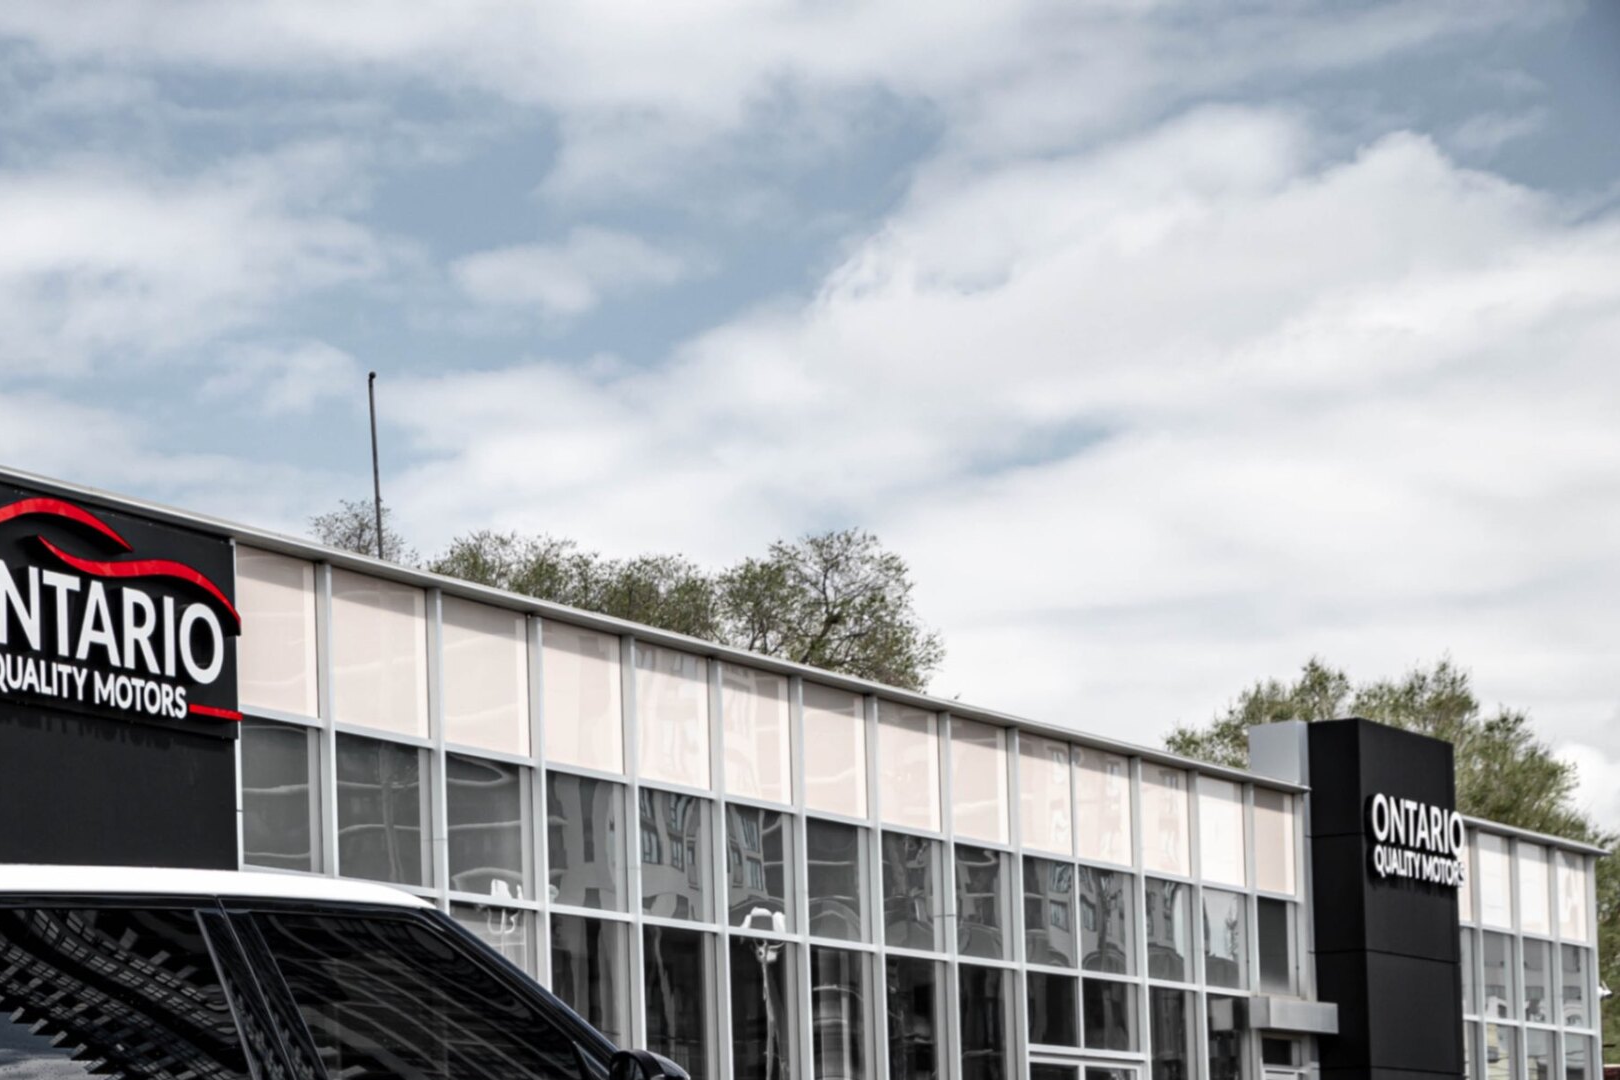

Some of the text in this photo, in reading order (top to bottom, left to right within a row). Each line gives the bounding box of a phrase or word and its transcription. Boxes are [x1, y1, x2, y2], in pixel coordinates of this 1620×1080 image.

[93, 670, 189, 720] MOTORS
[1371, 792, 1465, 858] ONTARIO
[1373, 844, 1466, 888] QUALITY MOTORS
